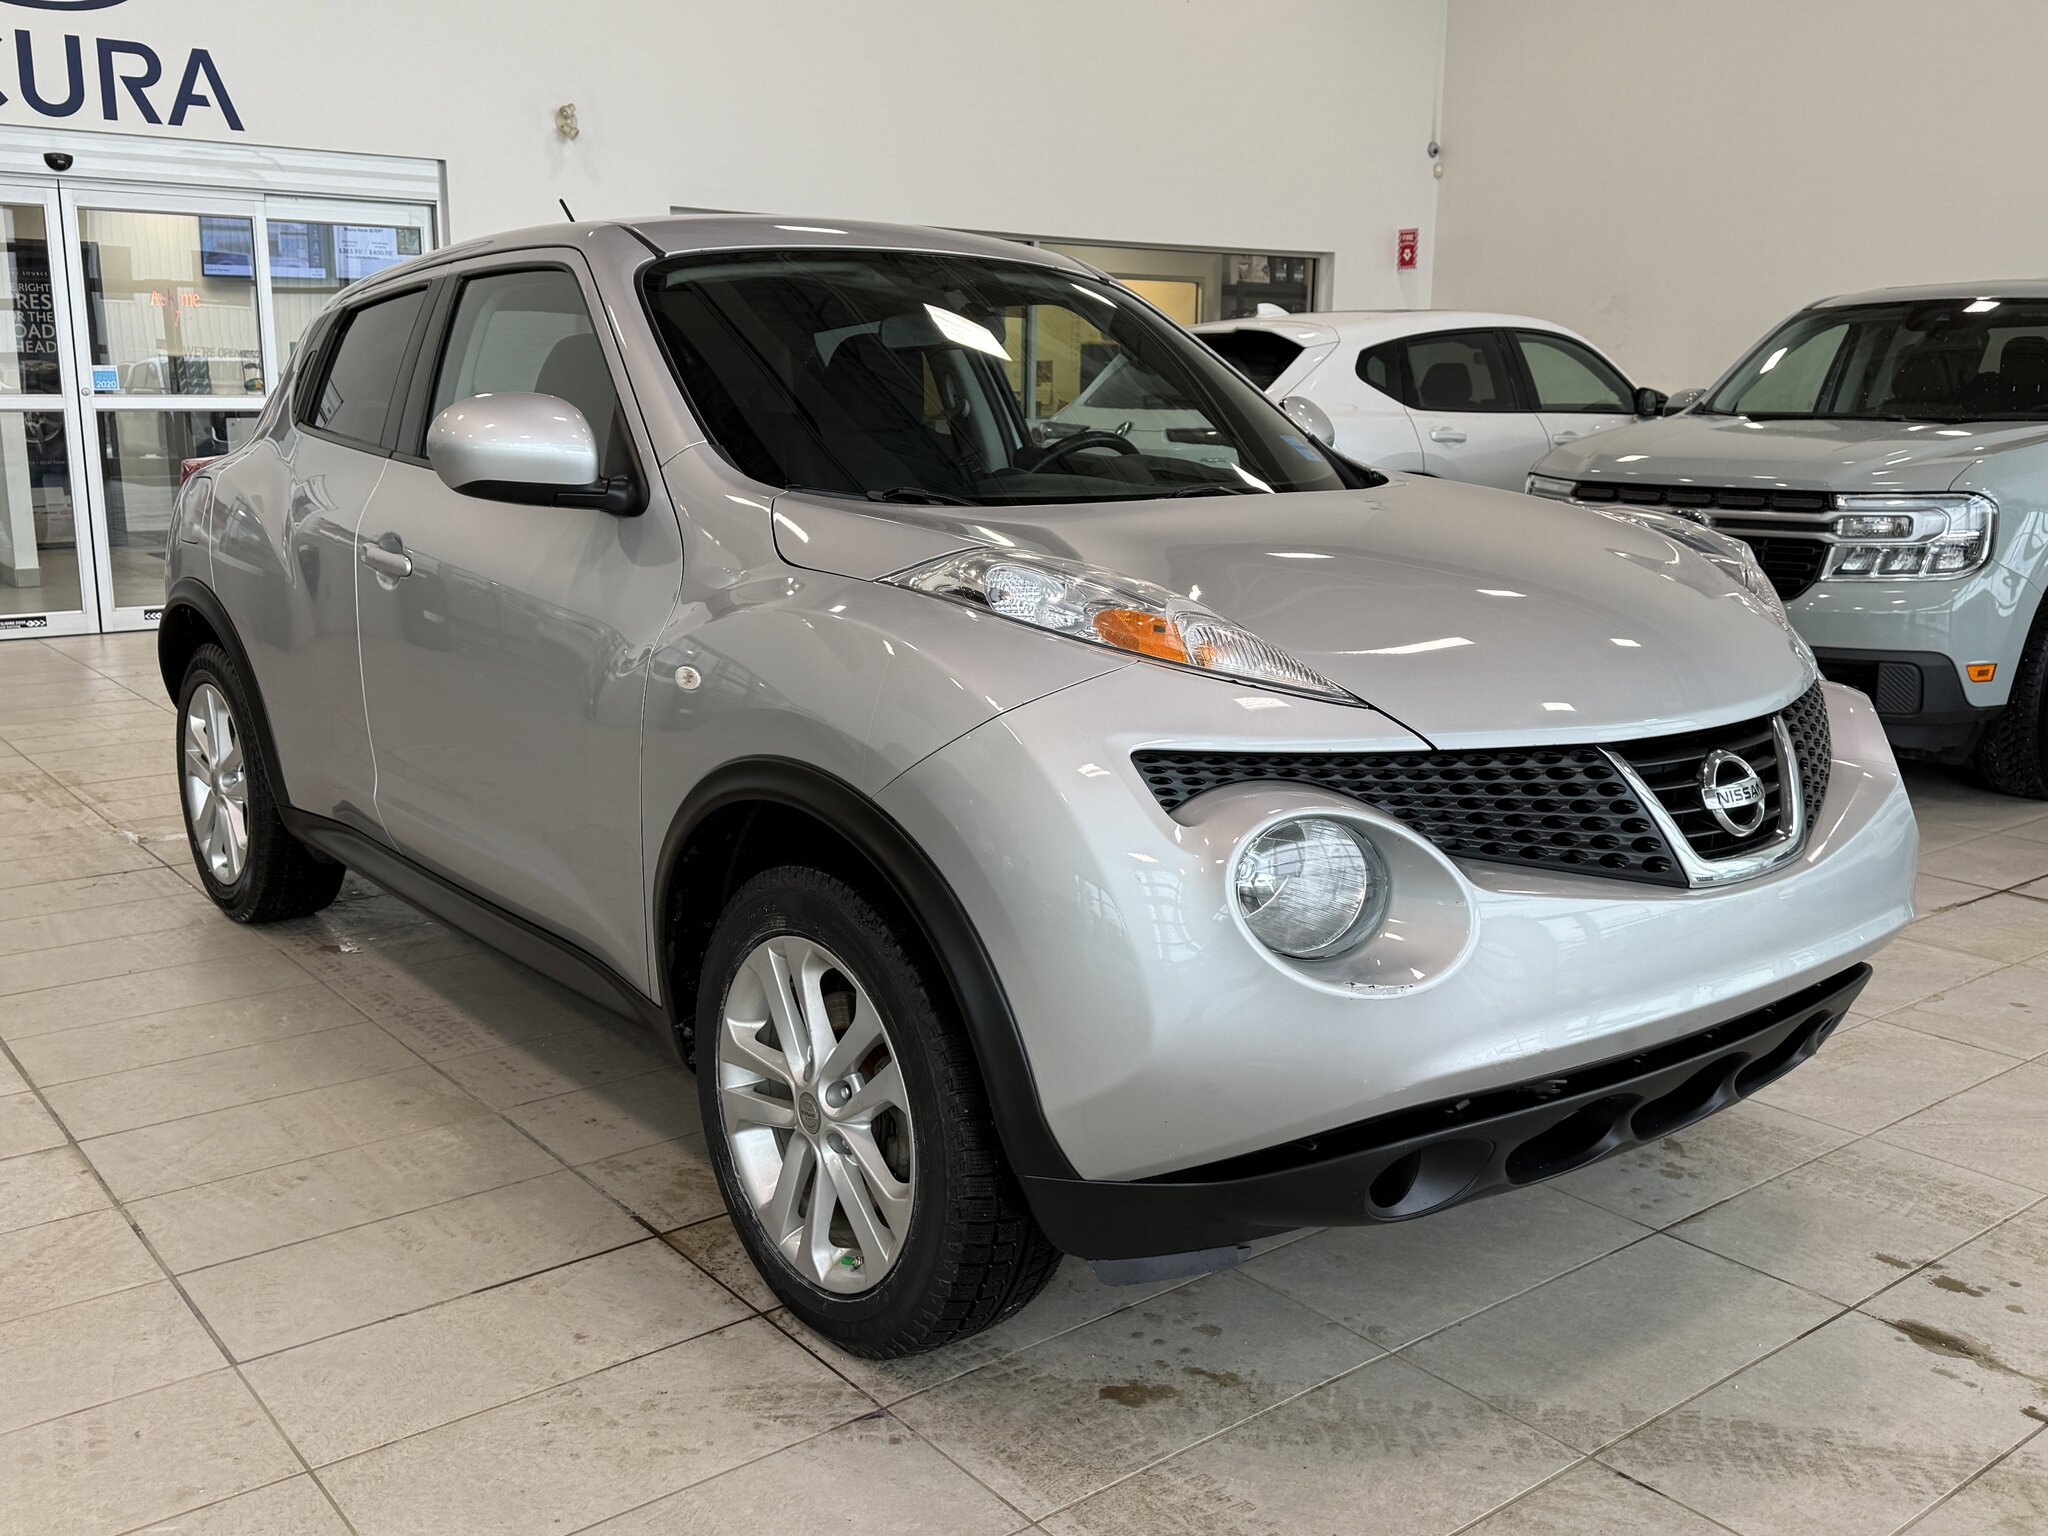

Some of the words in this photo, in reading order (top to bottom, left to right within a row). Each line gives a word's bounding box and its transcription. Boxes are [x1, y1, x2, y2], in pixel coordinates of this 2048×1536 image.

[0, 28, 246, 132] URA
[18, 282, 50, 292] RIGHT
[15, 293, 52, 310] RES
[180, 292, 201, 308] me
[27, 311, 54, 322] THE
[14, 323, 56, 339] OAD
[16, 340, 57, 353] HEAD
[95, 380, 117, 389] 2020
[1715, 781, 1763, 806] NISSAN
